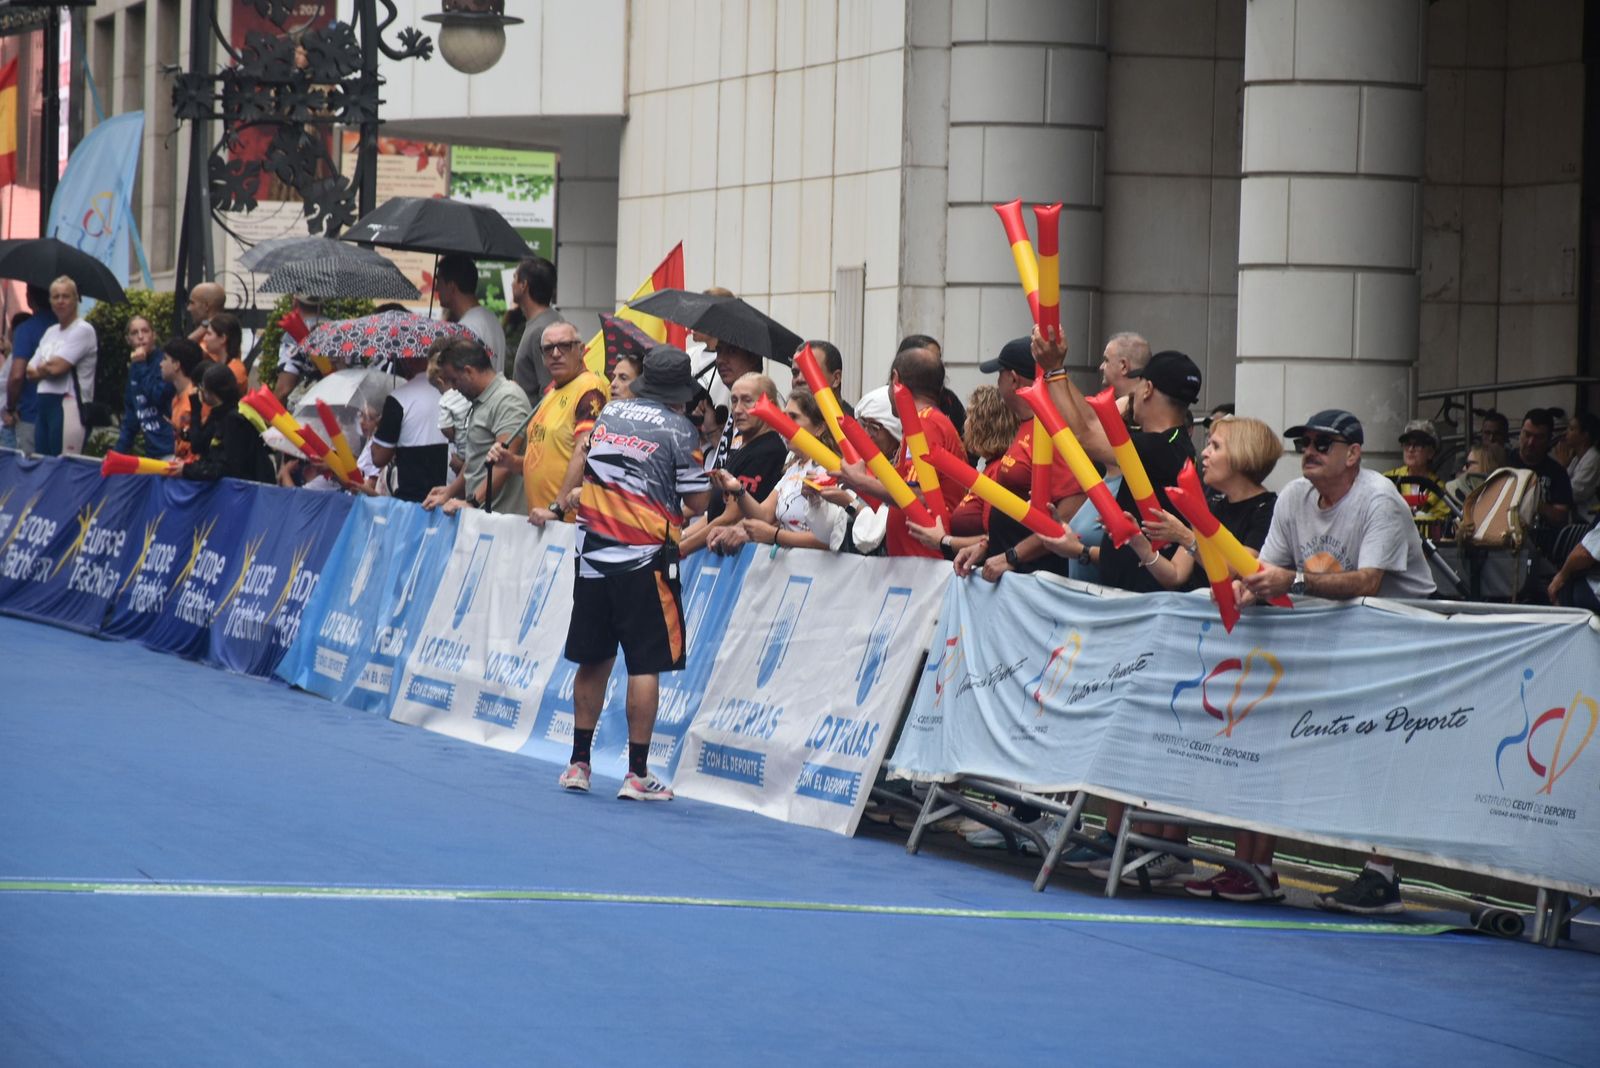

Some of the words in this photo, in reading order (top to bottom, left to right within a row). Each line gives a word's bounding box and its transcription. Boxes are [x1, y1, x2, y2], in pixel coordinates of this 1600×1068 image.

[141, 534, 177, 577] Europe
[190, 540, 226, 590] Europe
[240, 555, 277, 600] Europe
[417, 635, 471, 672] LOTERÍAS
[483, 650, 539, 690] LOTERÍAS
[709, 695, 783, 741] LOTERÍAS
[1291, 710, 1355, 739] Ceuta
[1356, 718, 1378, 735] es
[1385, 706, 1475, 744] Deporte
[706, 752, 721, 768] CON
[721, 756, 729, 771] EL
[730, 758, 758, 777] DEPORTE
[1152, 733, 1189, 748] INSTITUTO
[1222, 747, 1260, 762] DEPORTES
[814, 773, 823, 789] EL
[1475, 793, 1512, 808] INSTITUTO
[1544, 805, 1576, 820] DEPORTES
